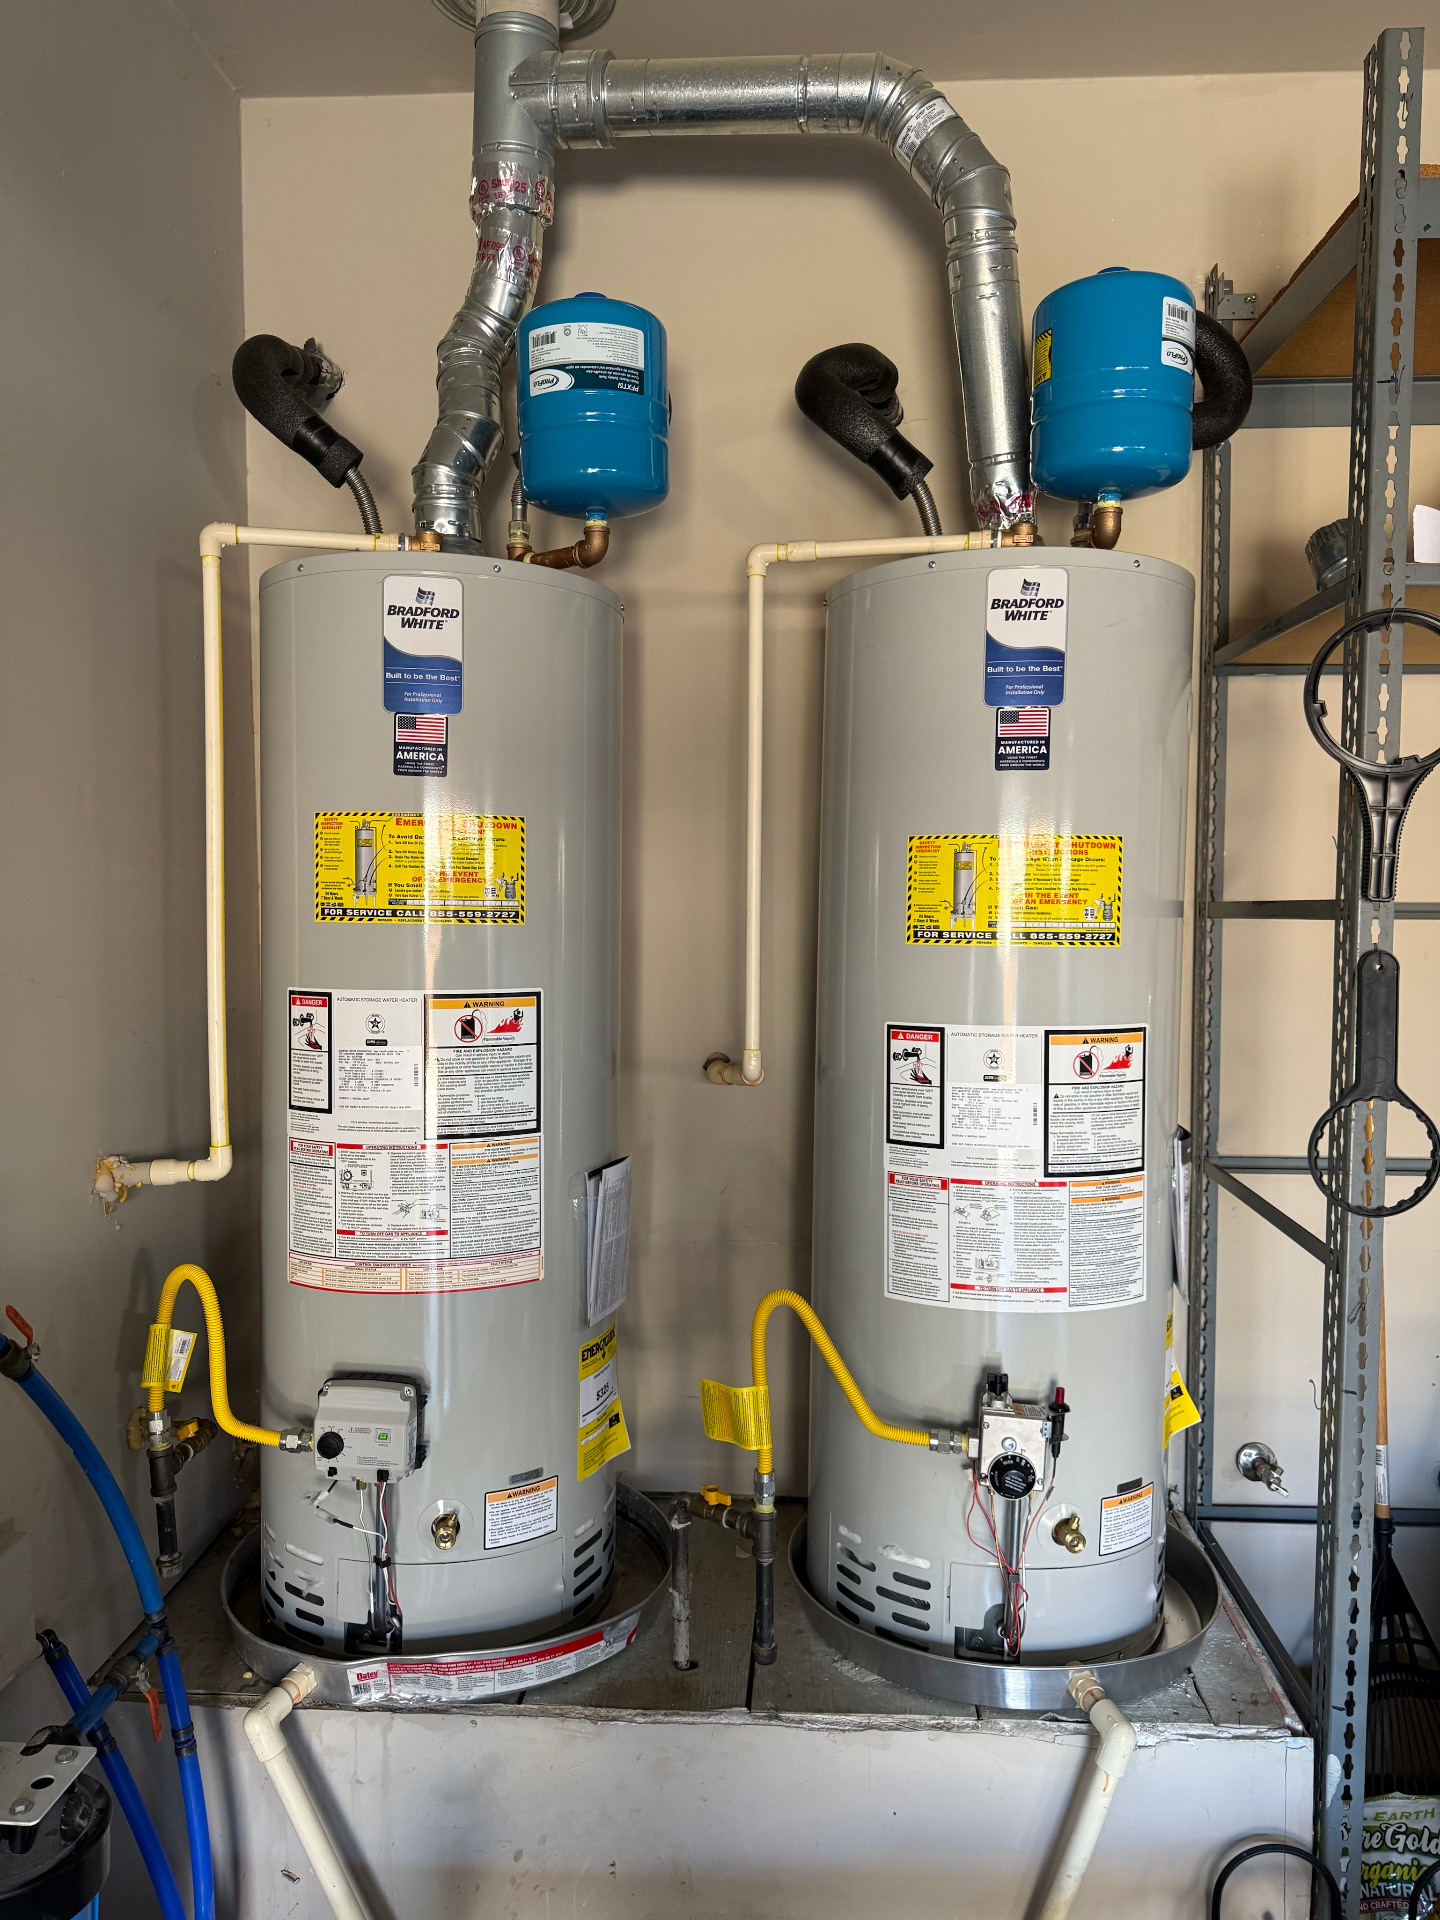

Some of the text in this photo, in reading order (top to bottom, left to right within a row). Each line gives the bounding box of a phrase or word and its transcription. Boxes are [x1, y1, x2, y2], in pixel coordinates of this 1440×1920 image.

[990, 598, 1065, 610] BRADFORD
[387, 605, 460, 619] BRADFORD
[997, 745, 1048, 755] AMERICA
[395, 750, 445, 762] AMERICA
[452, 870, 480, 878] EVENT
[346, 909, 392, 917] SERVICE
[942, 931, 992, 939] SERVICE
[1029, 932, 1113, 940] 855-559-2727
[301, 998, 323, 1006] DANGER
[905, 1033, 934, 1041] DANGER
[1090, 1036, 1119, 1044] WARNING
[596, 1381, 610, 1401] $325
[512, 1485, 541, 1498] WARNING
[1122, 1491, 1143, 1504] WARNING
[356, 1670, 379, 1682] Oatey
[1372, 1807, 1436, 1822] EARTH
[1370, 1900, 1410, 1910] CRAFTED
